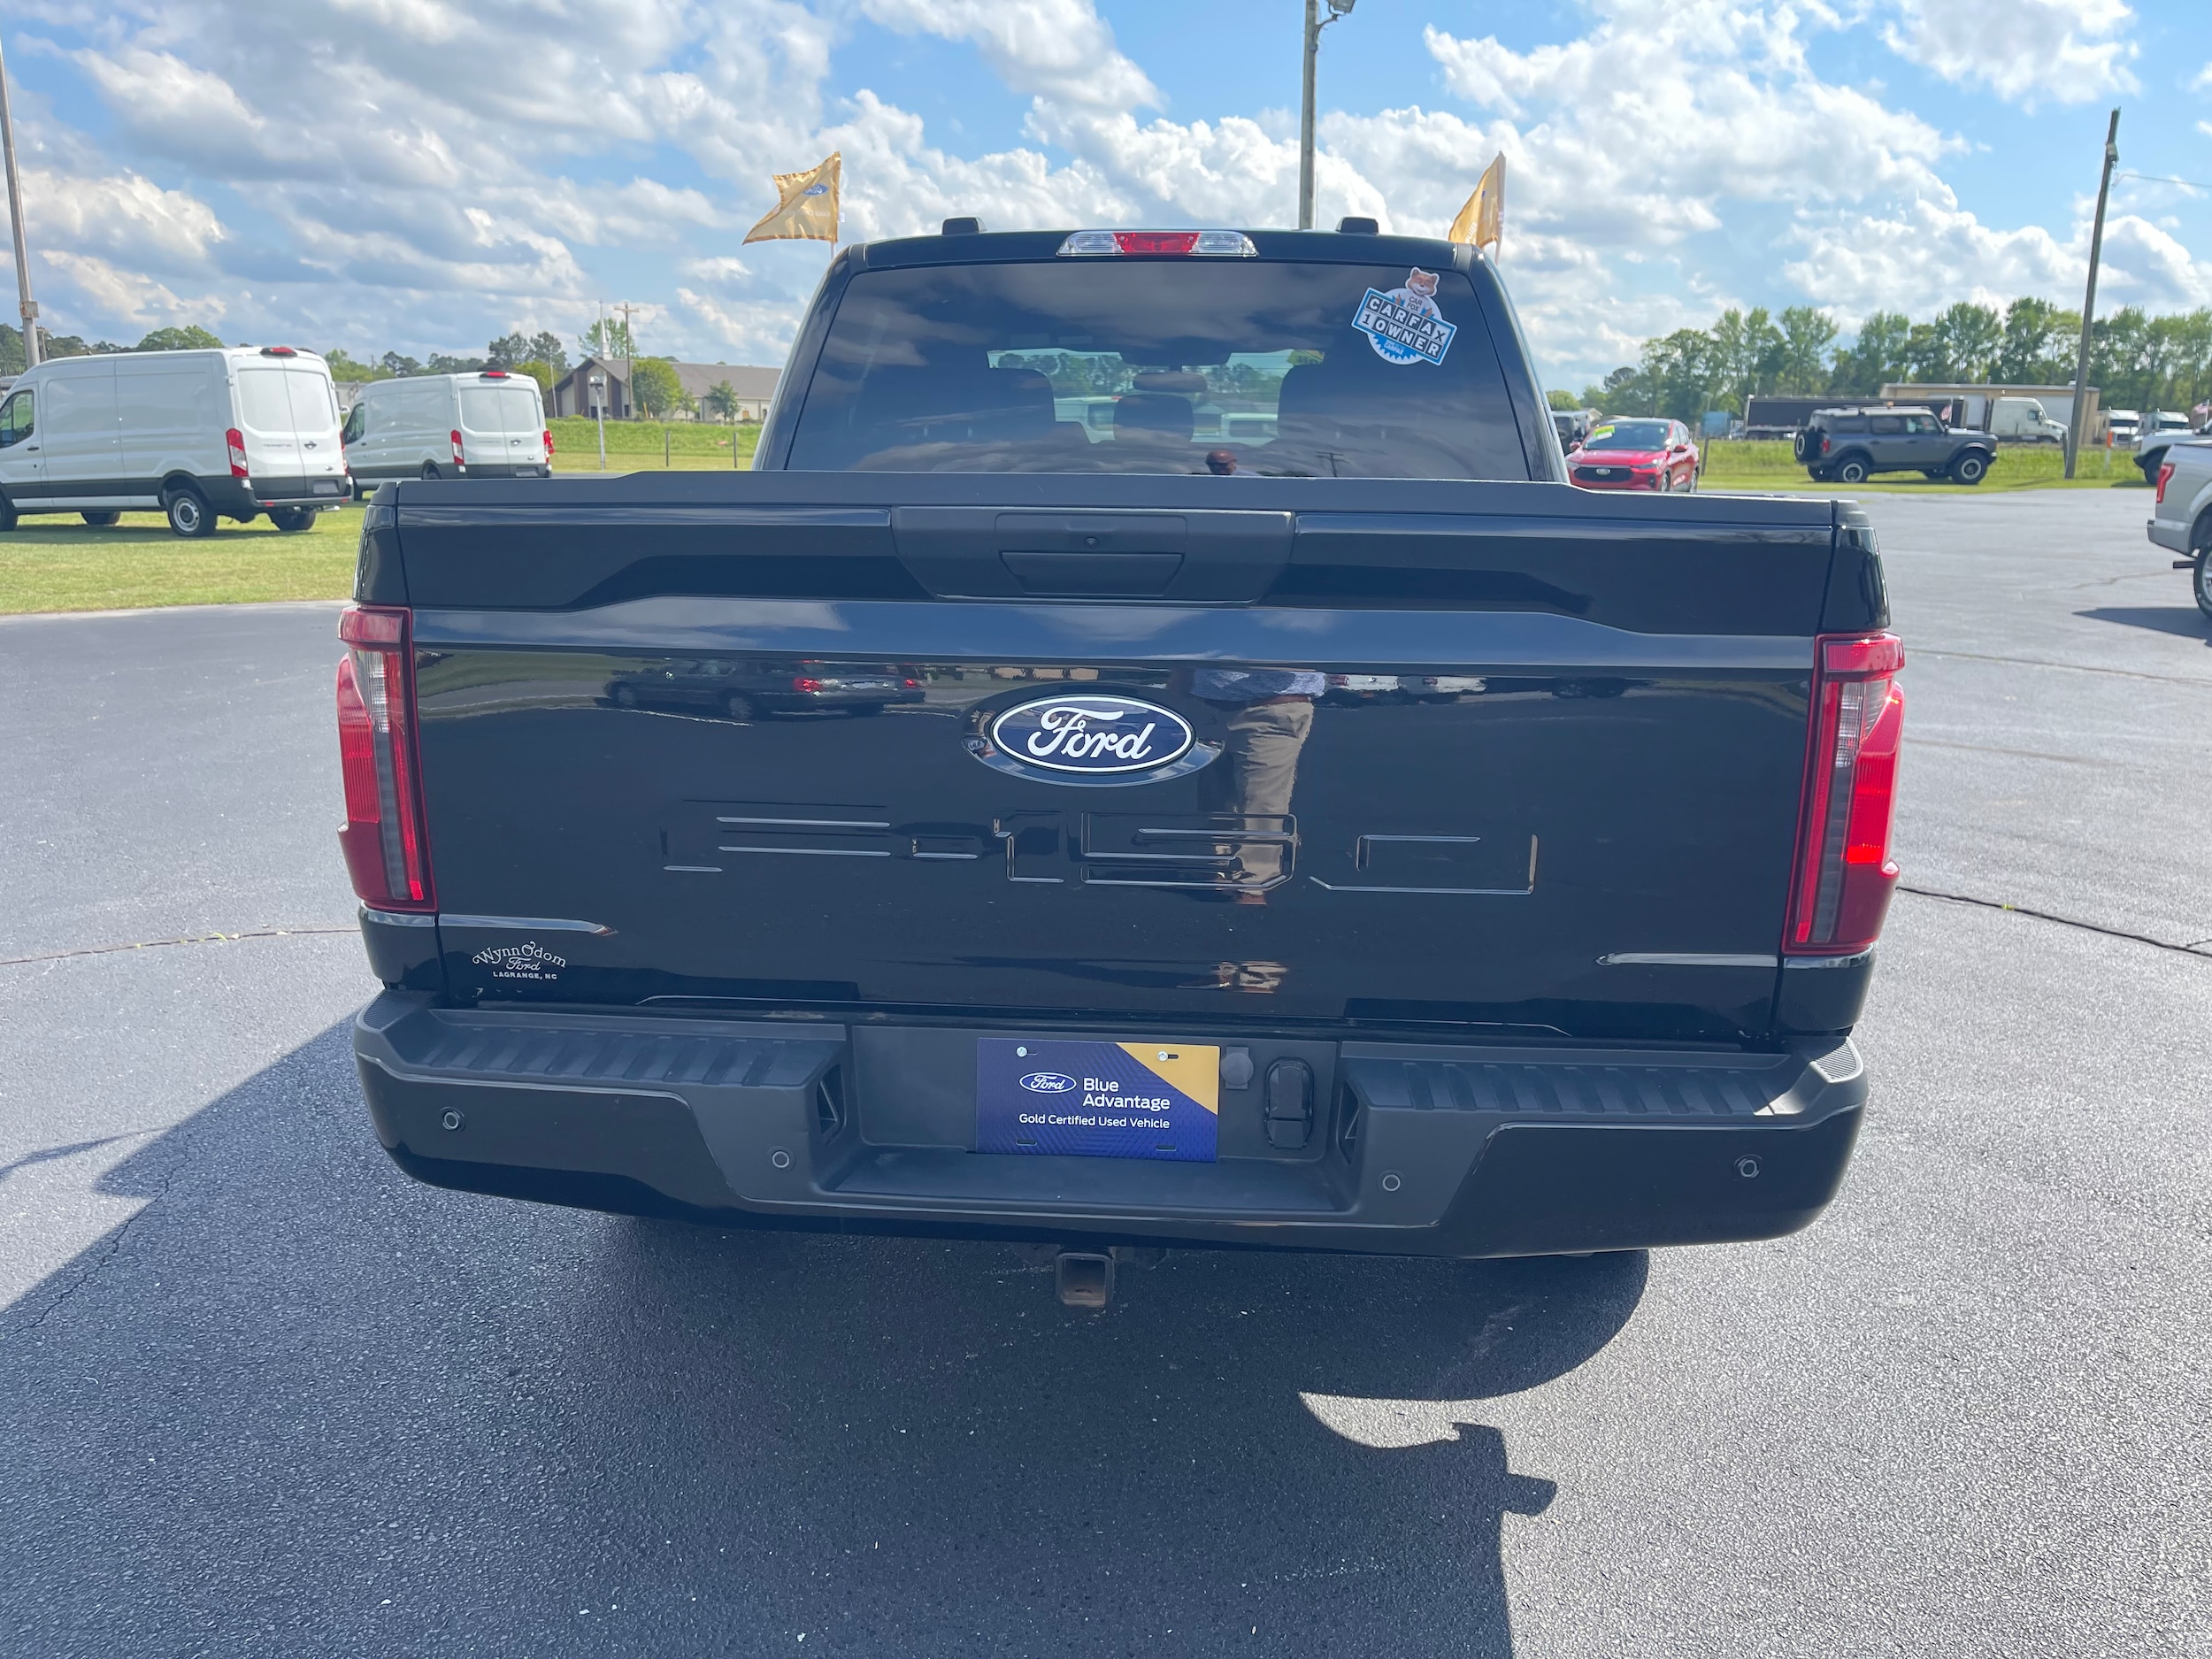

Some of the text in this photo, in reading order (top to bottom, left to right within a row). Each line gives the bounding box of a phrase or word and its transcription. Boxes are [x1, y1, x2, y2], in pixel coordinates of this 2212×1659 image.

[1406, 302, 1420, 311] FOX
[1409, 296, 1423, 306] CAR
[1369, 298, 1446, 342] CARFAX
[1362, 313, 1371, 326] 1
[1375, 319, 1440, 357] OWNER
[1027, 707, 1156, 759] Ford
[506, 956, 541, 971] Ford
[492, 971, 543, 980] LAGRANGE,
[1030, 1074, 1066, 1090] Ford
[1083, 1077, 1119, 1092] Blue
[1082, 1093, 1171, 1111] Advantage
[1018, 1113, 1170, 1128] Gold Certified Used Vehicle
